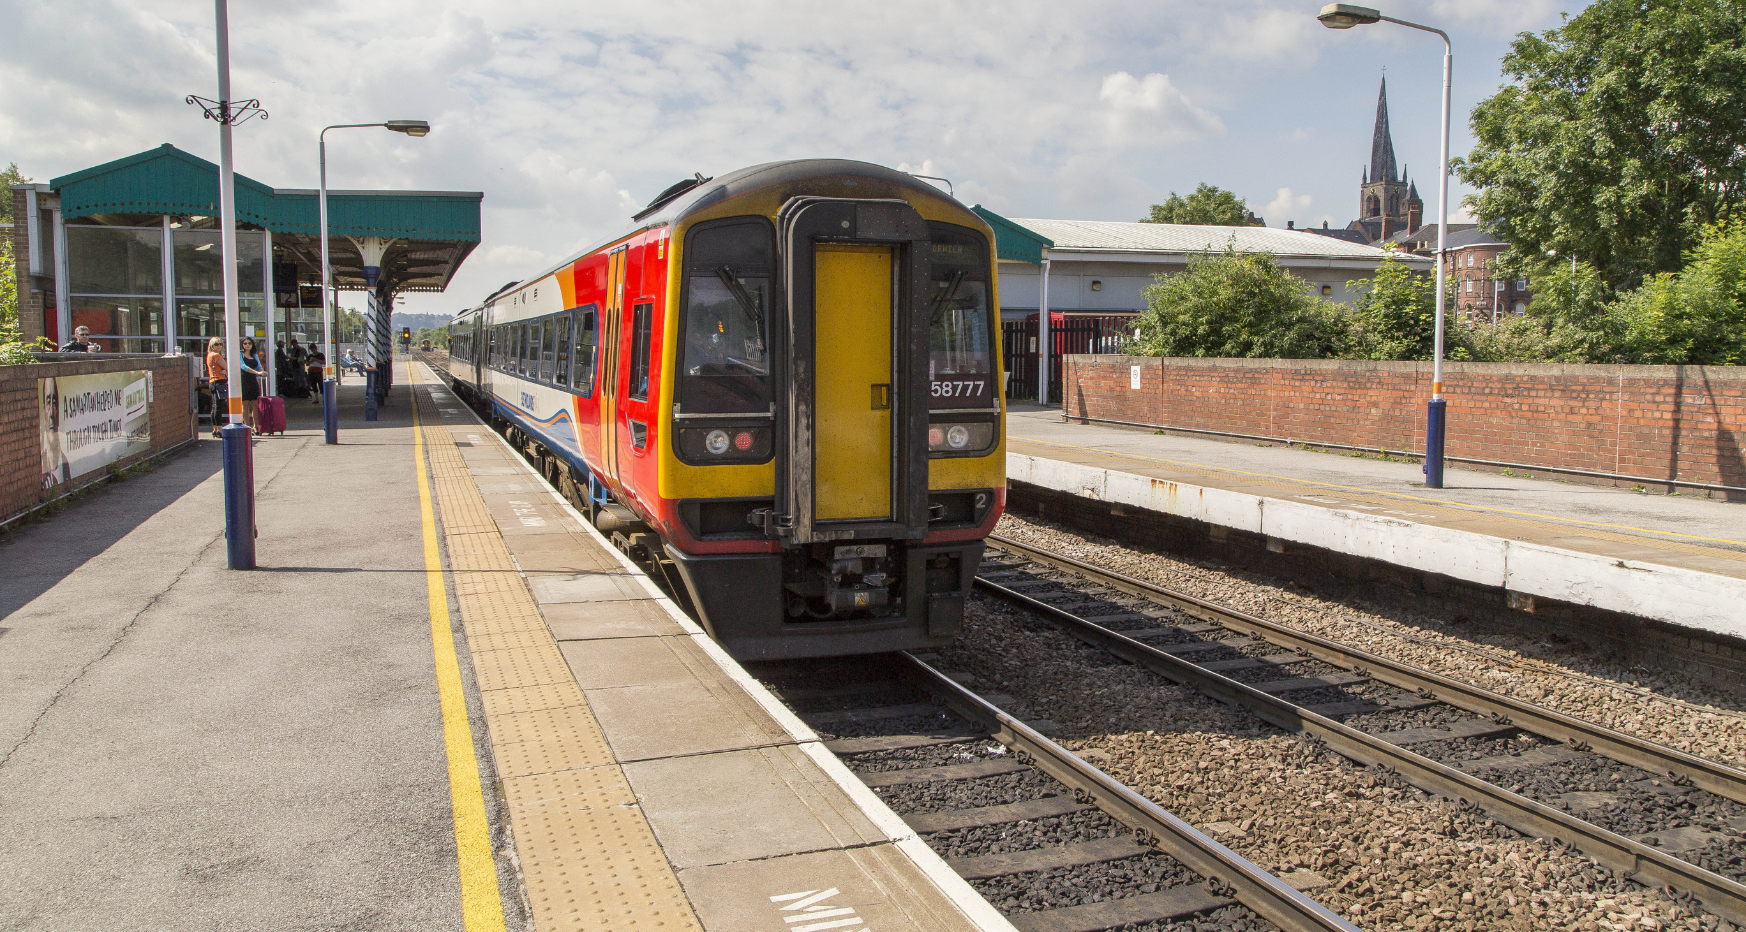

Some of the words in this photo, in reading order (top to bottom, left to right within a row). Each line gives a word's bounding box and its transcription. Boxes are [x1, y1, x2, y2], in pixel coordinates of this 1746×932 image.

[284, 292, 293, 303] 2
[931, 381, 985, 397] 58777
[63, 395, 68, 420] A
[114, 389, 121, 407] ME
[66, 425, 91, 453] THROUGH
[92, 421, 108, 444] TOUGH
[109, 418, 122, 439] TIMES
[976, 493, 987, 508] 2
[769, 887, 871, 932] MI
